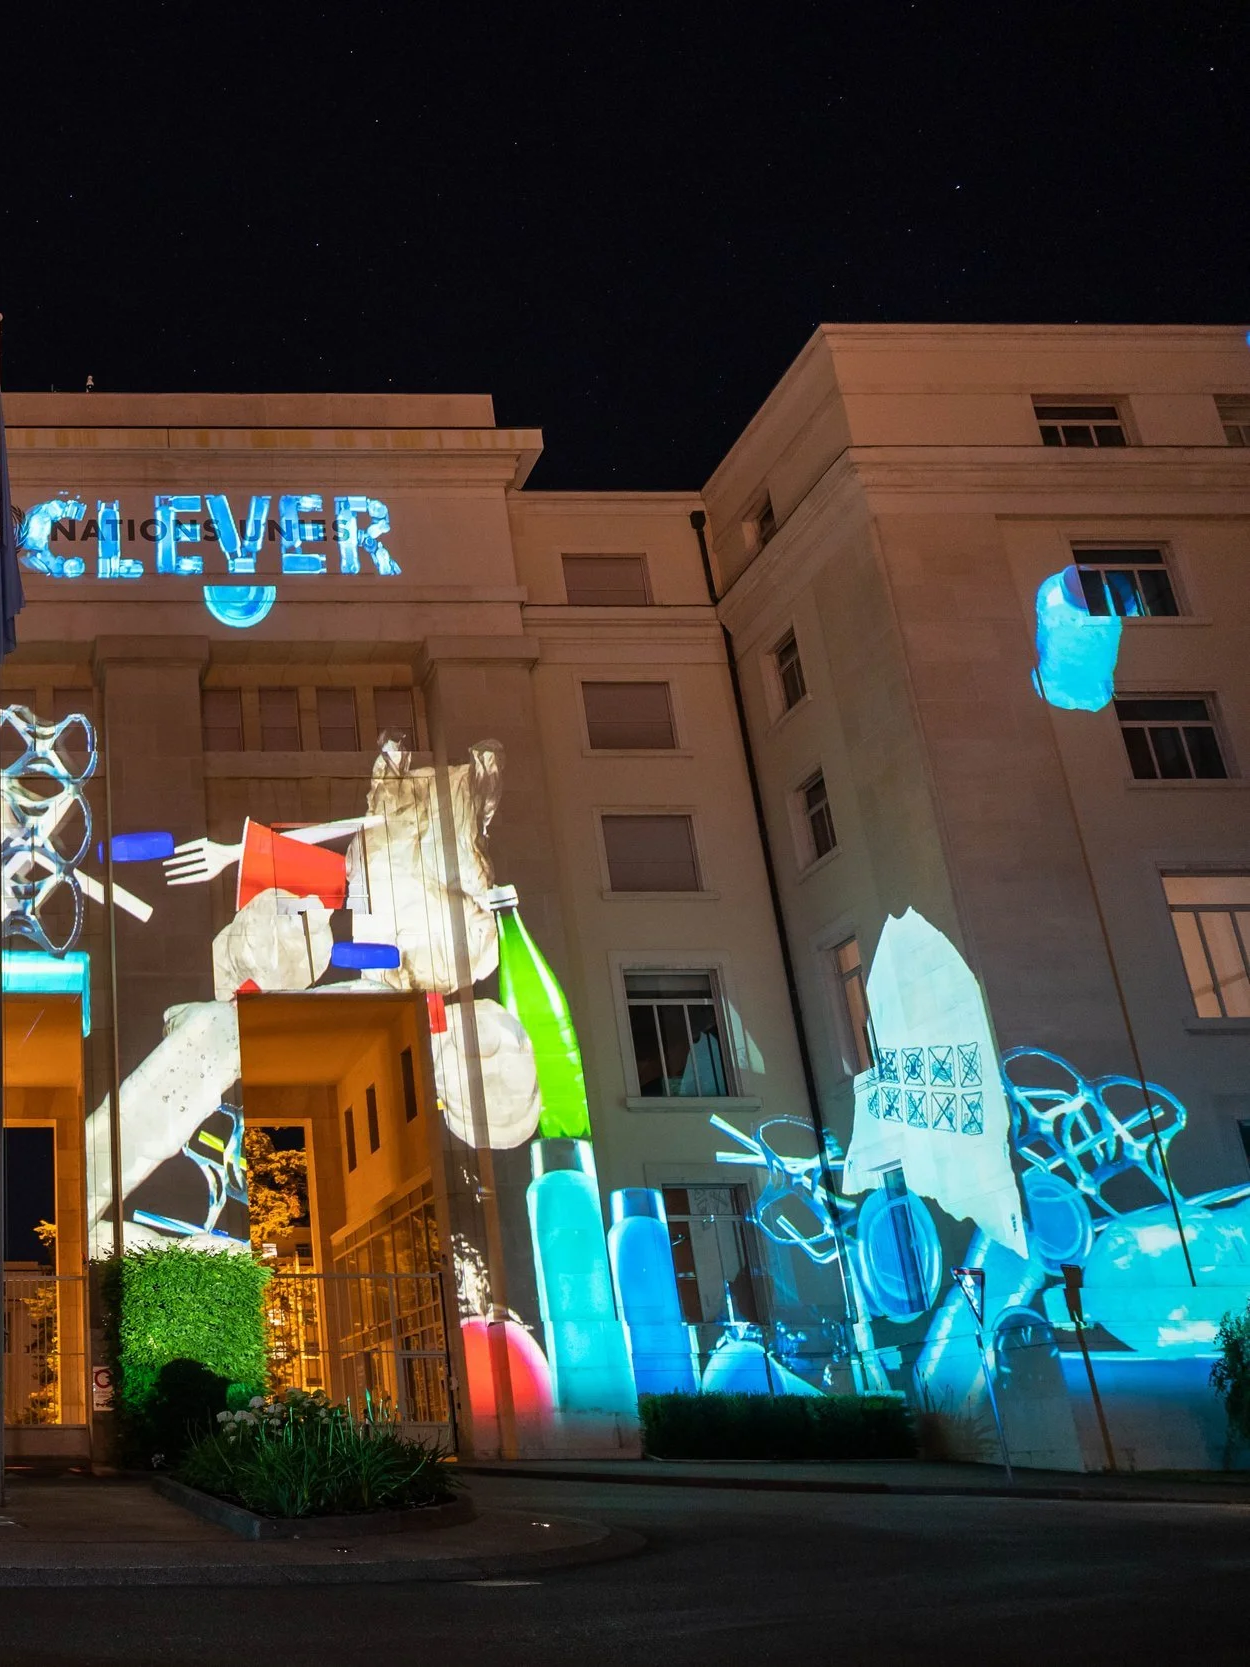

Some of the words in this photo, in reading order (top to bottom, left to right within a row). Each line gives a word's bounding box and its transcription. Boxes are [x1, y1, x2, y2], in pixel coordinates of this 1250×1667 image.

[20, 493, 402, 579] CLEVER
[51, 518, 222, 542] NATIONS
[239, 518, 351, 542] UNIES
